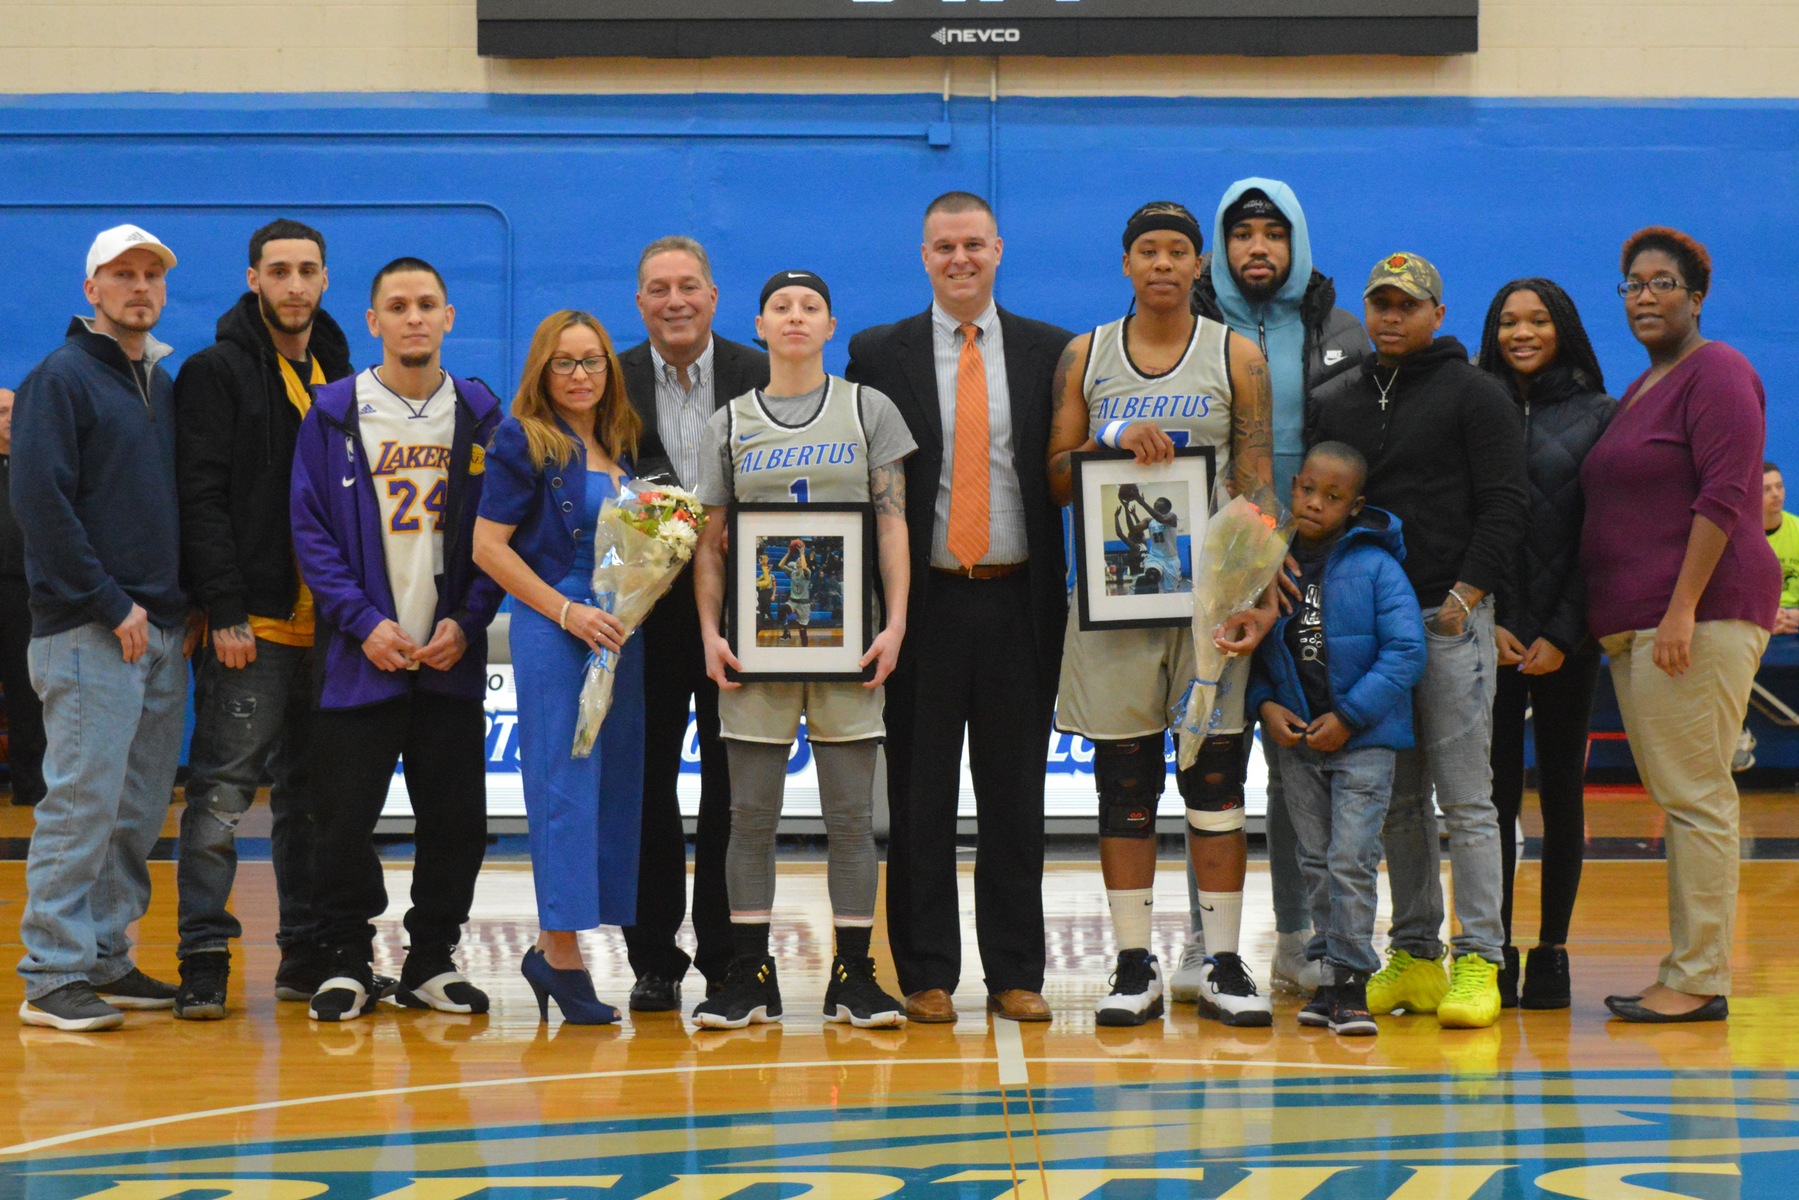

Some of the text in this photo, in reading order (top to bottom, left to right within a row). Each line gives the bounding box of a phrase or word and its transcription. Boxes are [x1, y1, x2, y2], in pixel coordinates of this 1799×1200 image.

[947, 29, 1020, 42] NEVCO
[1097, 395, 1213, 419] ALBERTUS
[373, 440, 452, 478] LAKER
[740, 442, 858, 474] ALBERTUS
[788, 477, 809, 502] 1
[386, 477, 449, 534] 24
